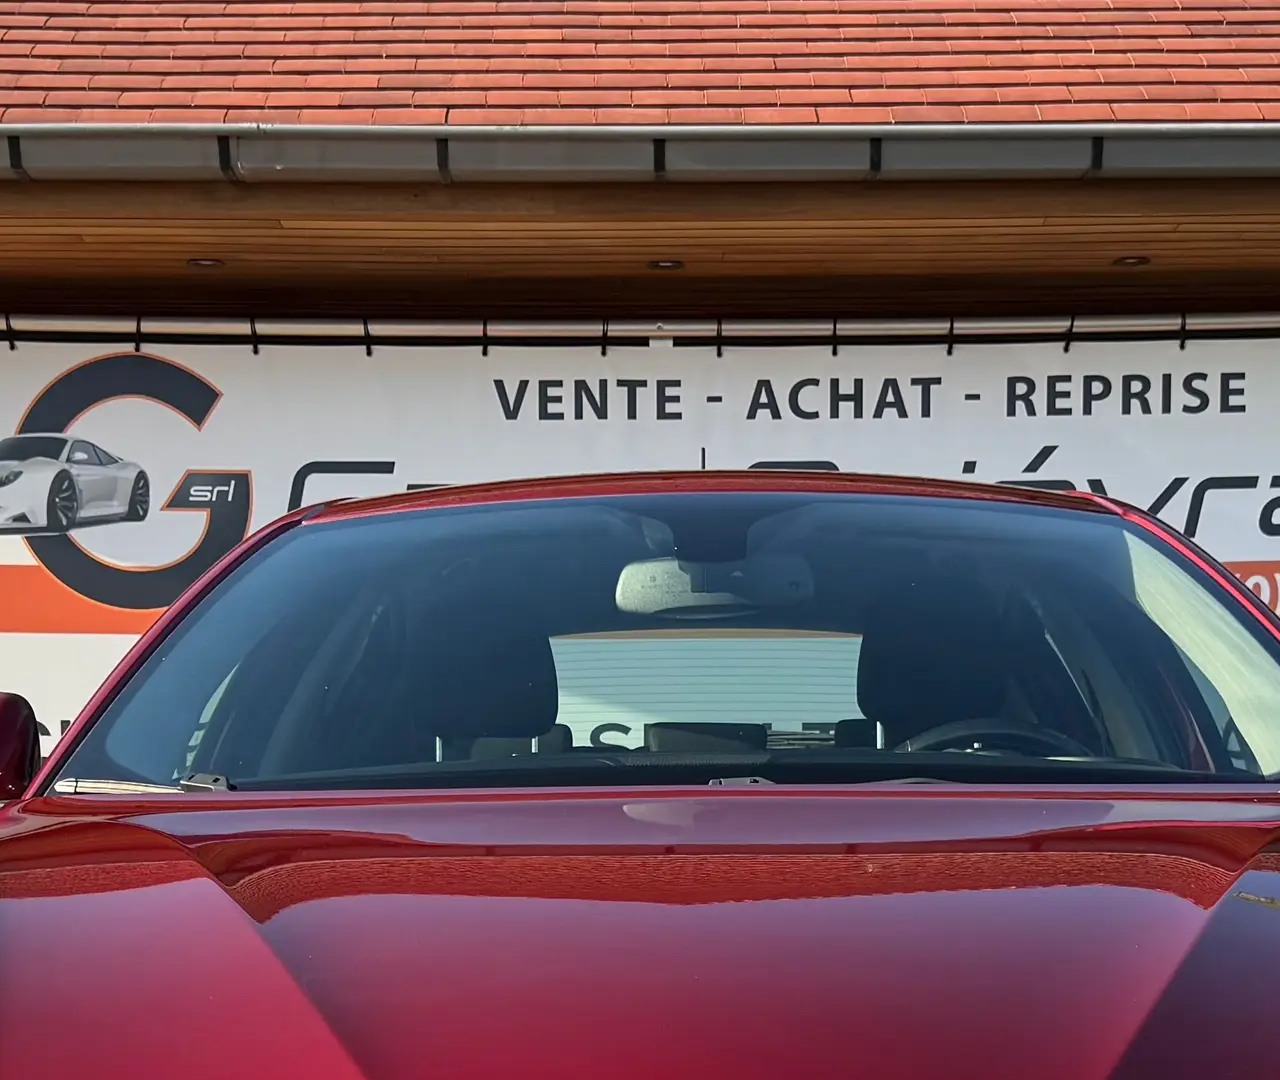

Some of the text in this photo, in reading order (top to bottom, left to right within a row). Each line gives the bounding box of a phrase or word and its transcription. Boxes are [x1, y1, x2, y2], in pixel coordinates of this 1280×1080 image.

[493, 379, 683, 421] VENTE
[747, 376, 942, 420] ACHAT
[1006, 371, 1247, 417] REPRISE
[188, 479, 235, 502] srl
